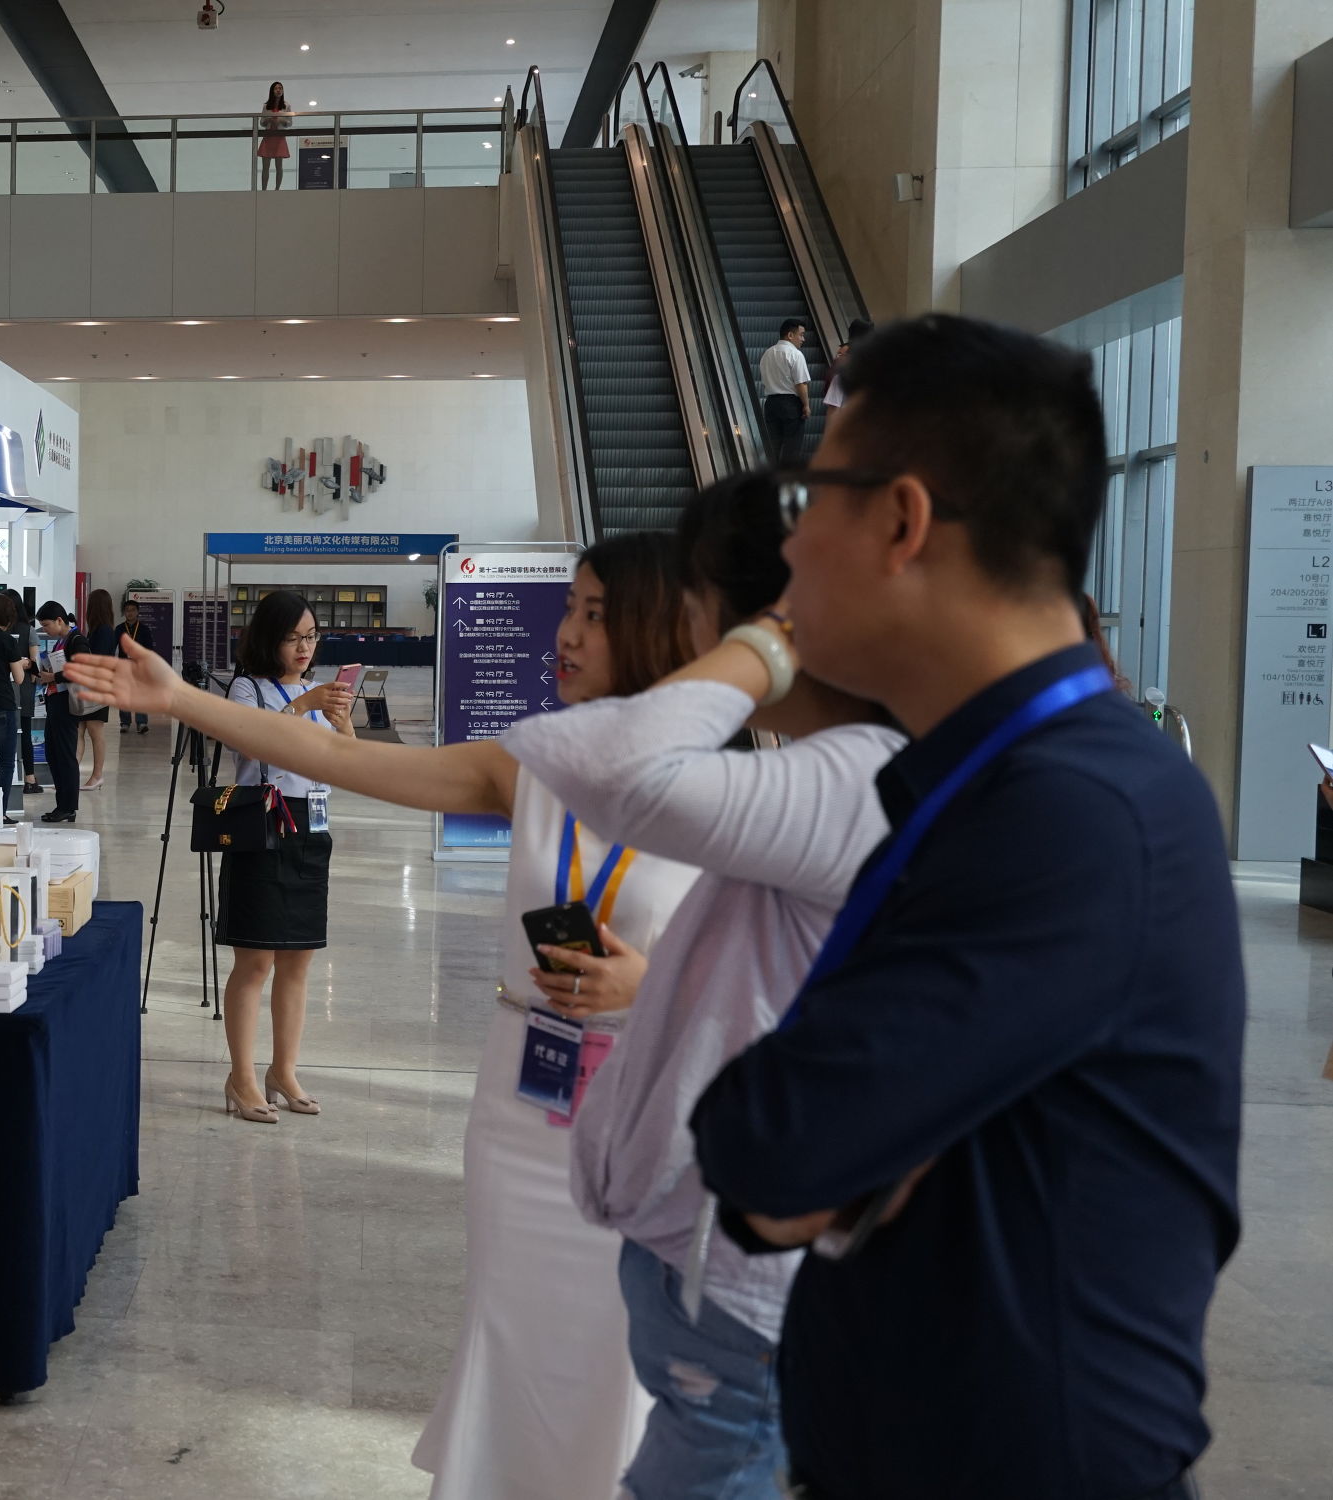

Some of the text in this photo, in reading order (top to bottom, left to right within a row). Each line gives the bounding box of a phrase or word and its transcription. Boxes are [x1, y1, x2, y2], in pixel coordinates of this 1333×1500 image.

[1316, 480, 1333, 491] L3
[265, 536, 399, 545] 北京美丽风尚文化传媒有限公司
[1312, 556, 1329, 567] L2
[1300, 574, 1329, 582] 10号门
[1309, 625, 1325, 637] L1
[1298, 645, 1326, 653] 欢悦厅
[1262, 674, 1324, 682] 104/105/106室
